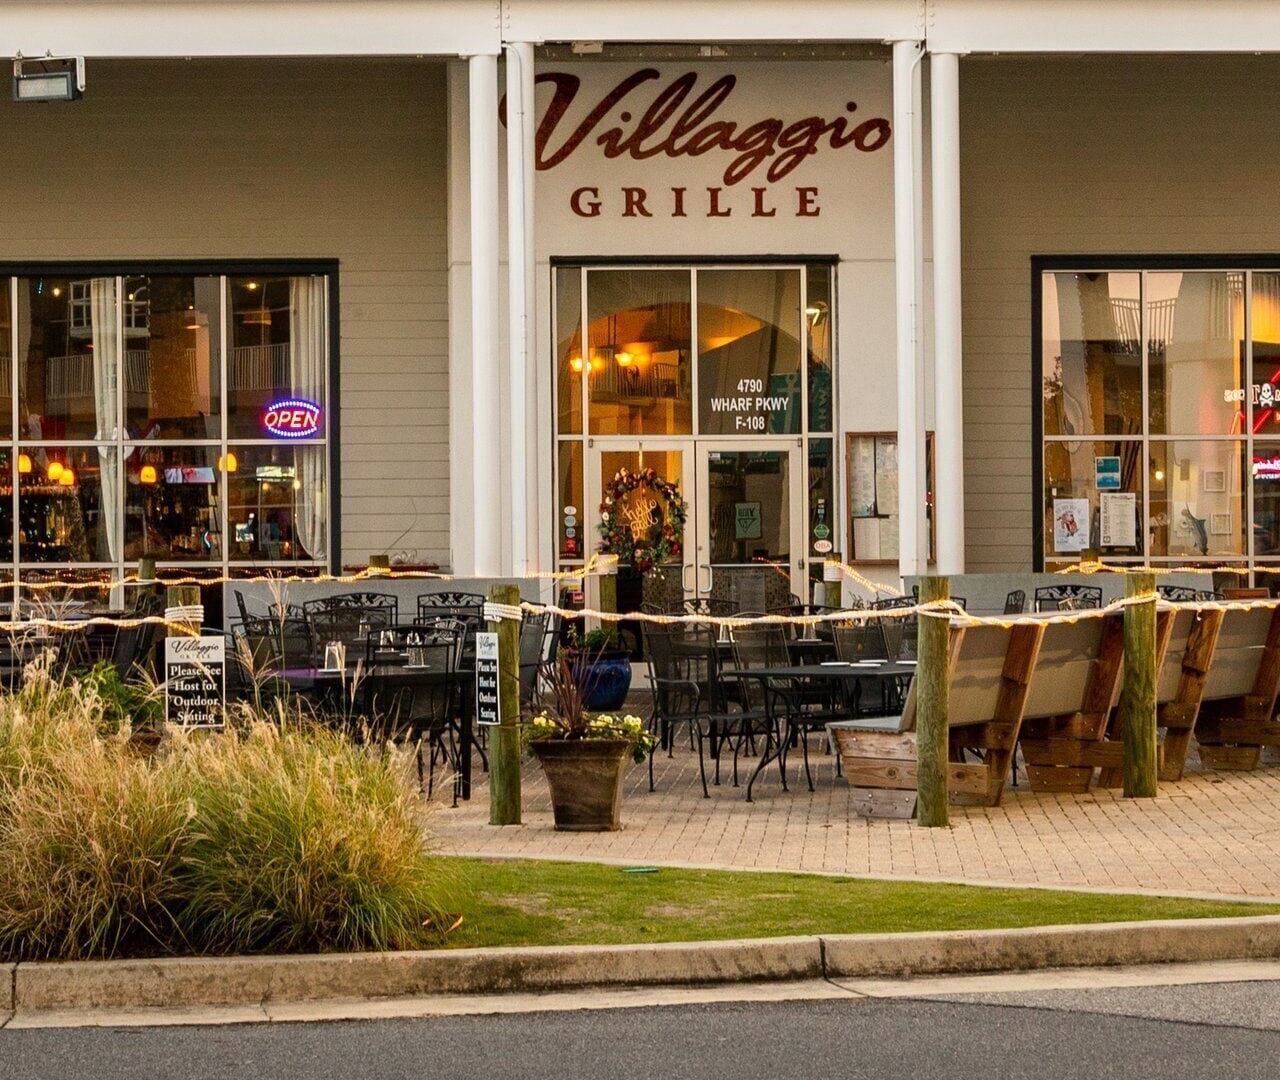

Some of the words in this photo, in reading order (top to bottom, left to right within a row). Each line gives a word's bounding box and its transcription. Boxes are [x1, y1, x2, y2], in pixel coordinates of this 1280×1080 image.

[498, 69, 892, 186] Villaggio
[570, 187, 821, 218] GRILLE
[737, 378, 762, 393] 4790
[711, 397, 753, 412] WHARF
[755, 397, 789, 411] PKWY
[264, 410, 318, 428] OPEN
[735, 415, 766, 430] F-108
[170, 664, 202, 676] Please
[174, 679, 200, 692] Host
[202, 679, 218, 692] for
[173, 695, 219, 707] Outdoor
